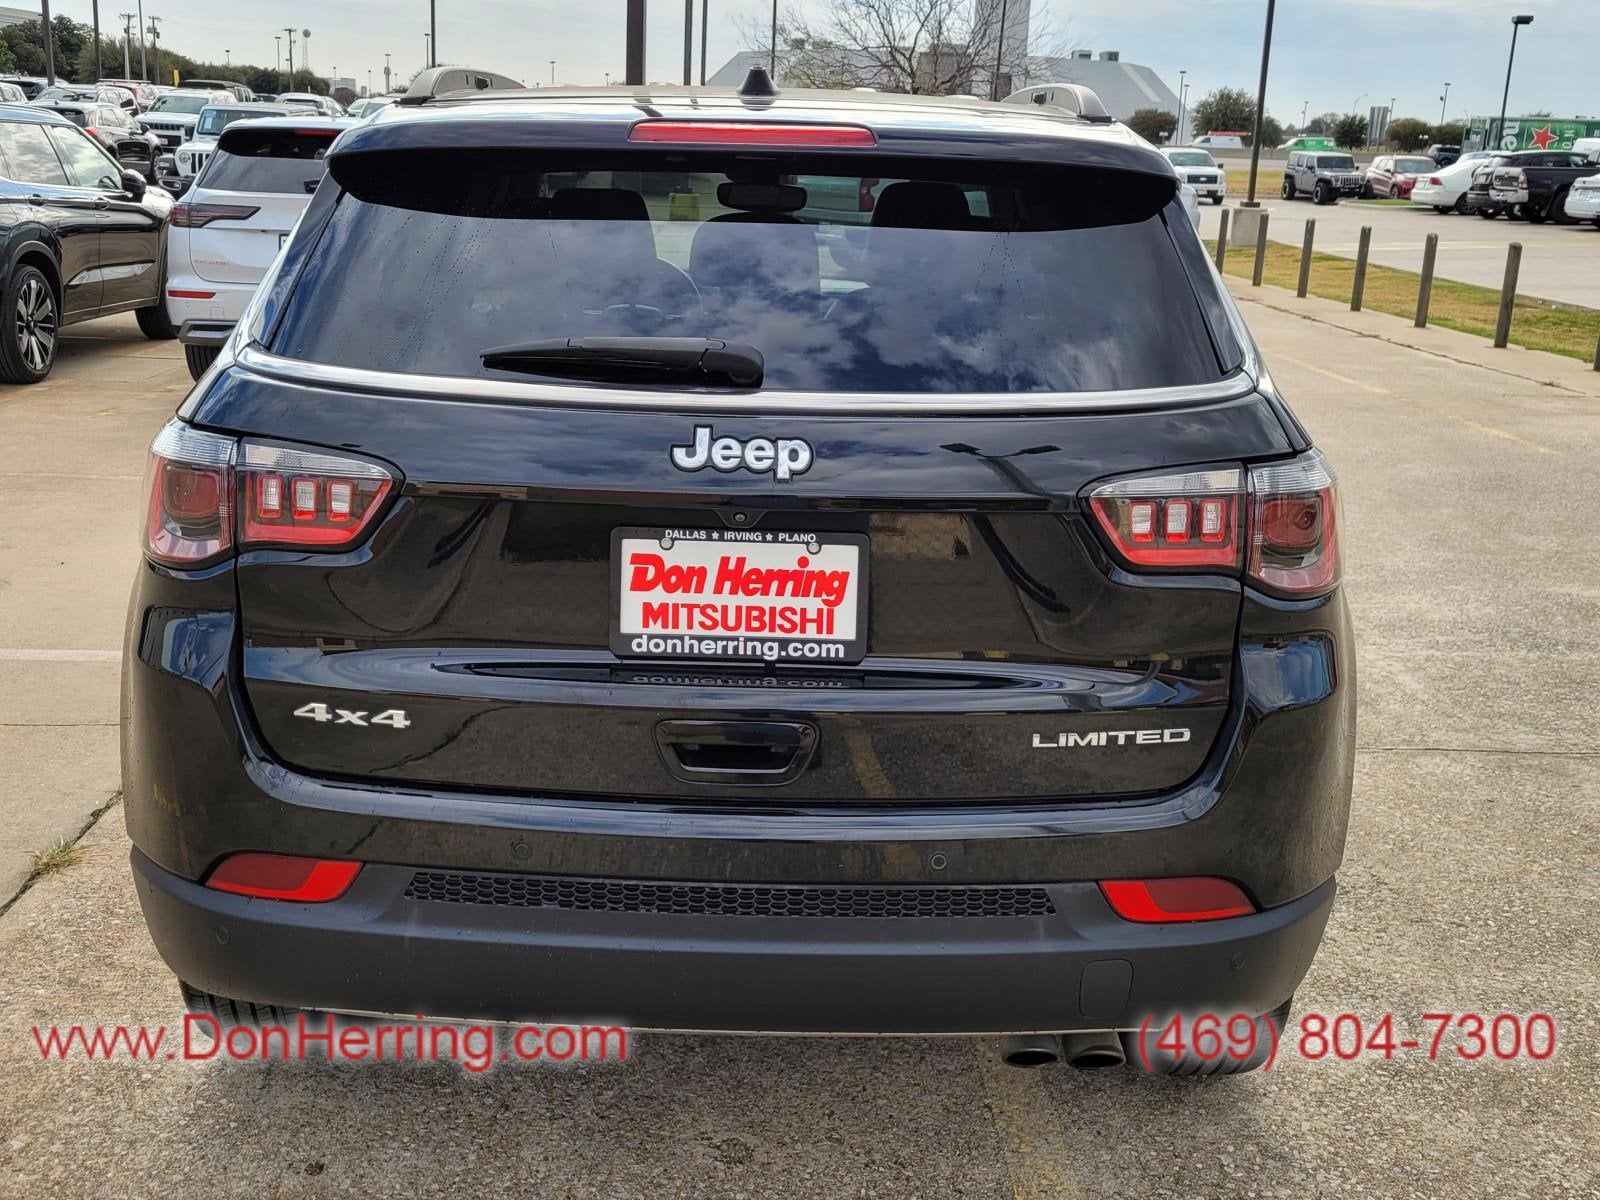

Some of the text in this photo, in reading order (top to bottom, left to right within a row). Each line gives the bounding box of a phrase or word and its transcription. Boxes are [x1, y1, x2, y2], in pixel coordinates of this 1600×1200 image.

[672, 426, 812, 480] Jeep
[665, 529, 817, 543] DALLAS IRVING PLANO
[629, 552, 850, 607] Don Herring
[641, 602, 835, 635] MITSUBISHI
[631, 634, 845, 661] donherring.com
[1032, 728, 1191, 748] LIMITED
